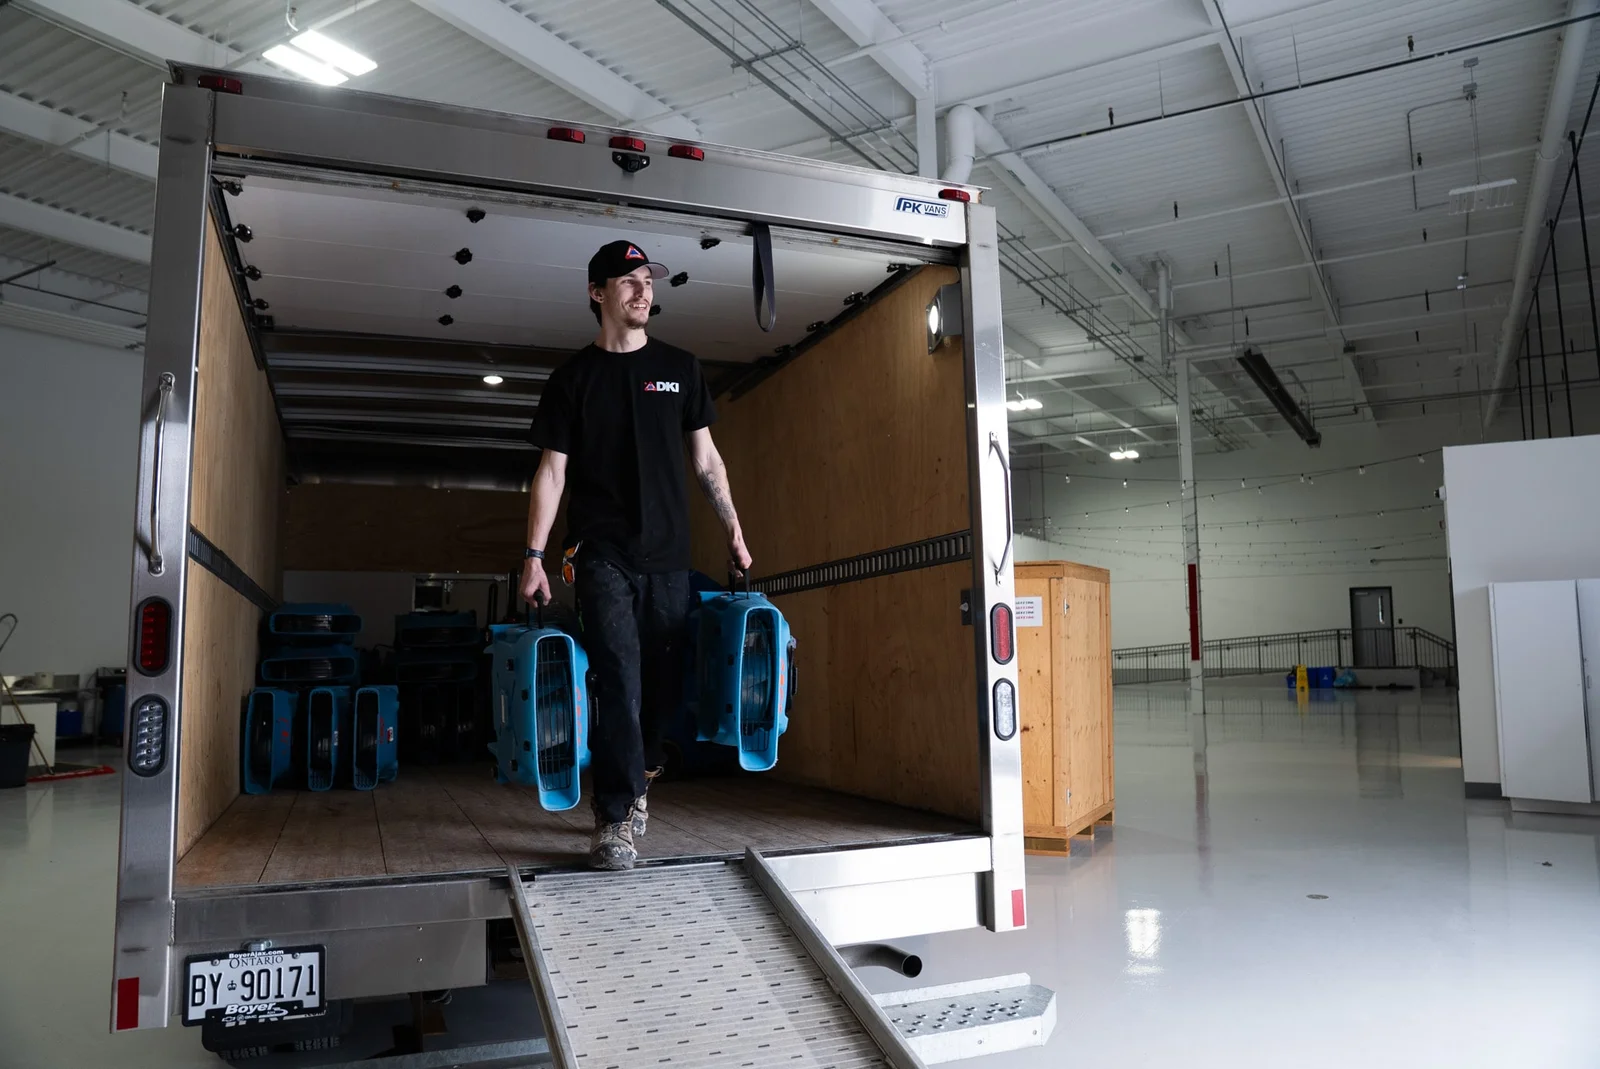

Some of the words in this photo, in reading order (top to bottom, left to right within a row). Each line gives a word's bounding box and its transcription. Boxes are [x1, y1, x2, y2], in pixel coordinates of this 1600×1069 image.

[924, 204, 947, 215] VANS
[656, 381, 679, 393] DKI
[229, 950, 284, 958] BoyerAjax.com
[229, 955, 283, 969] ONTARIO
[191, 972, 223, 1007] BY
[240, 964, 316, 1001] 90171
[225, 1002, 276, 1015] Boyer
